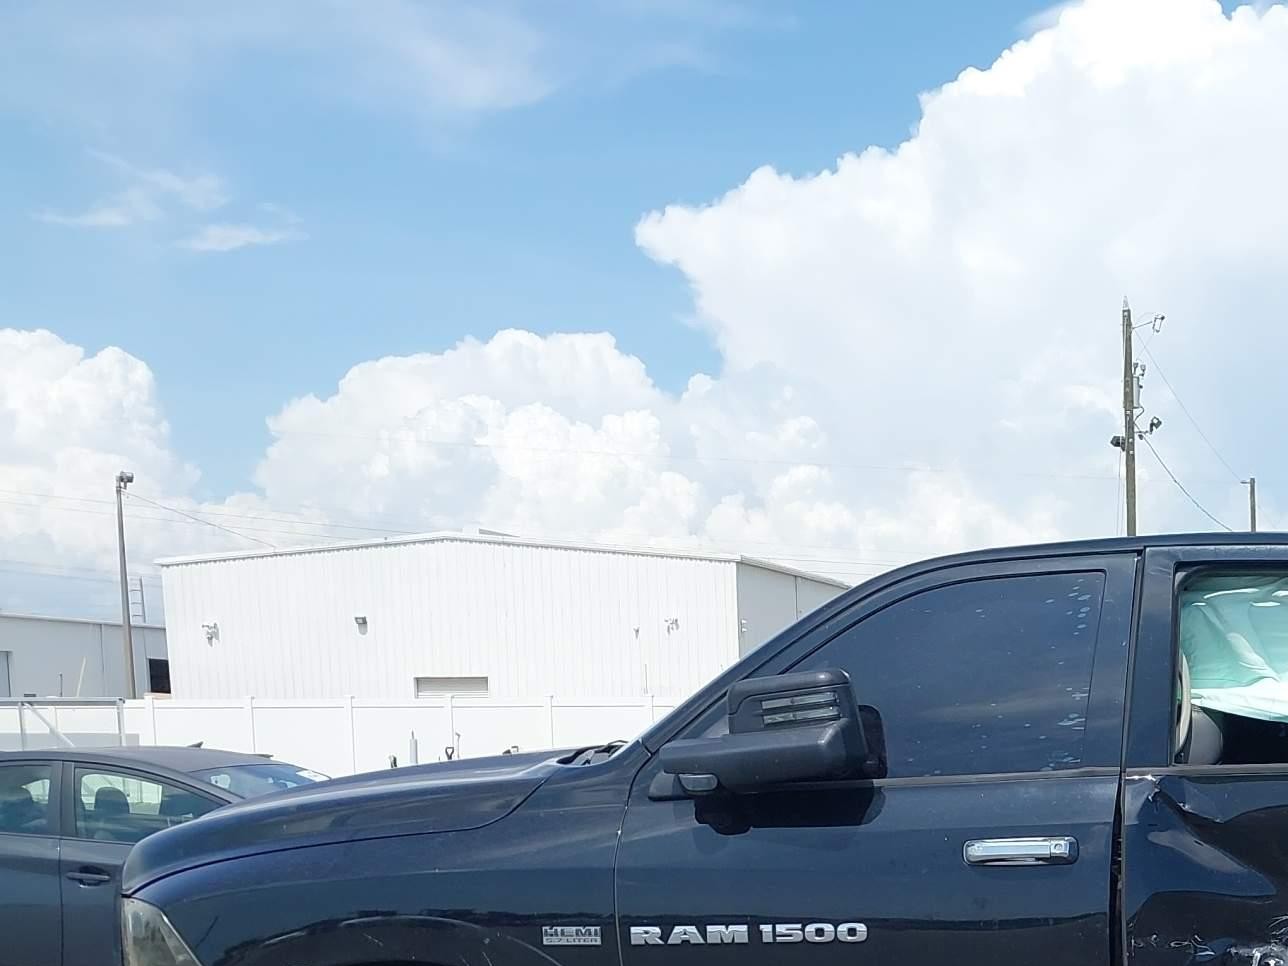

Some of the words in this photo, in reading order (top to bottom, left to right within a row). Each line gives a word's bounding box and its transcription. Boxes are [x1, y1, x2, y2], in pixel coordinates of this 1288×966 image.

[543, 928, 600, 937] HEMI
[630, 925, 749, 945] RAM
[760, 923, 868, 943] 1500
